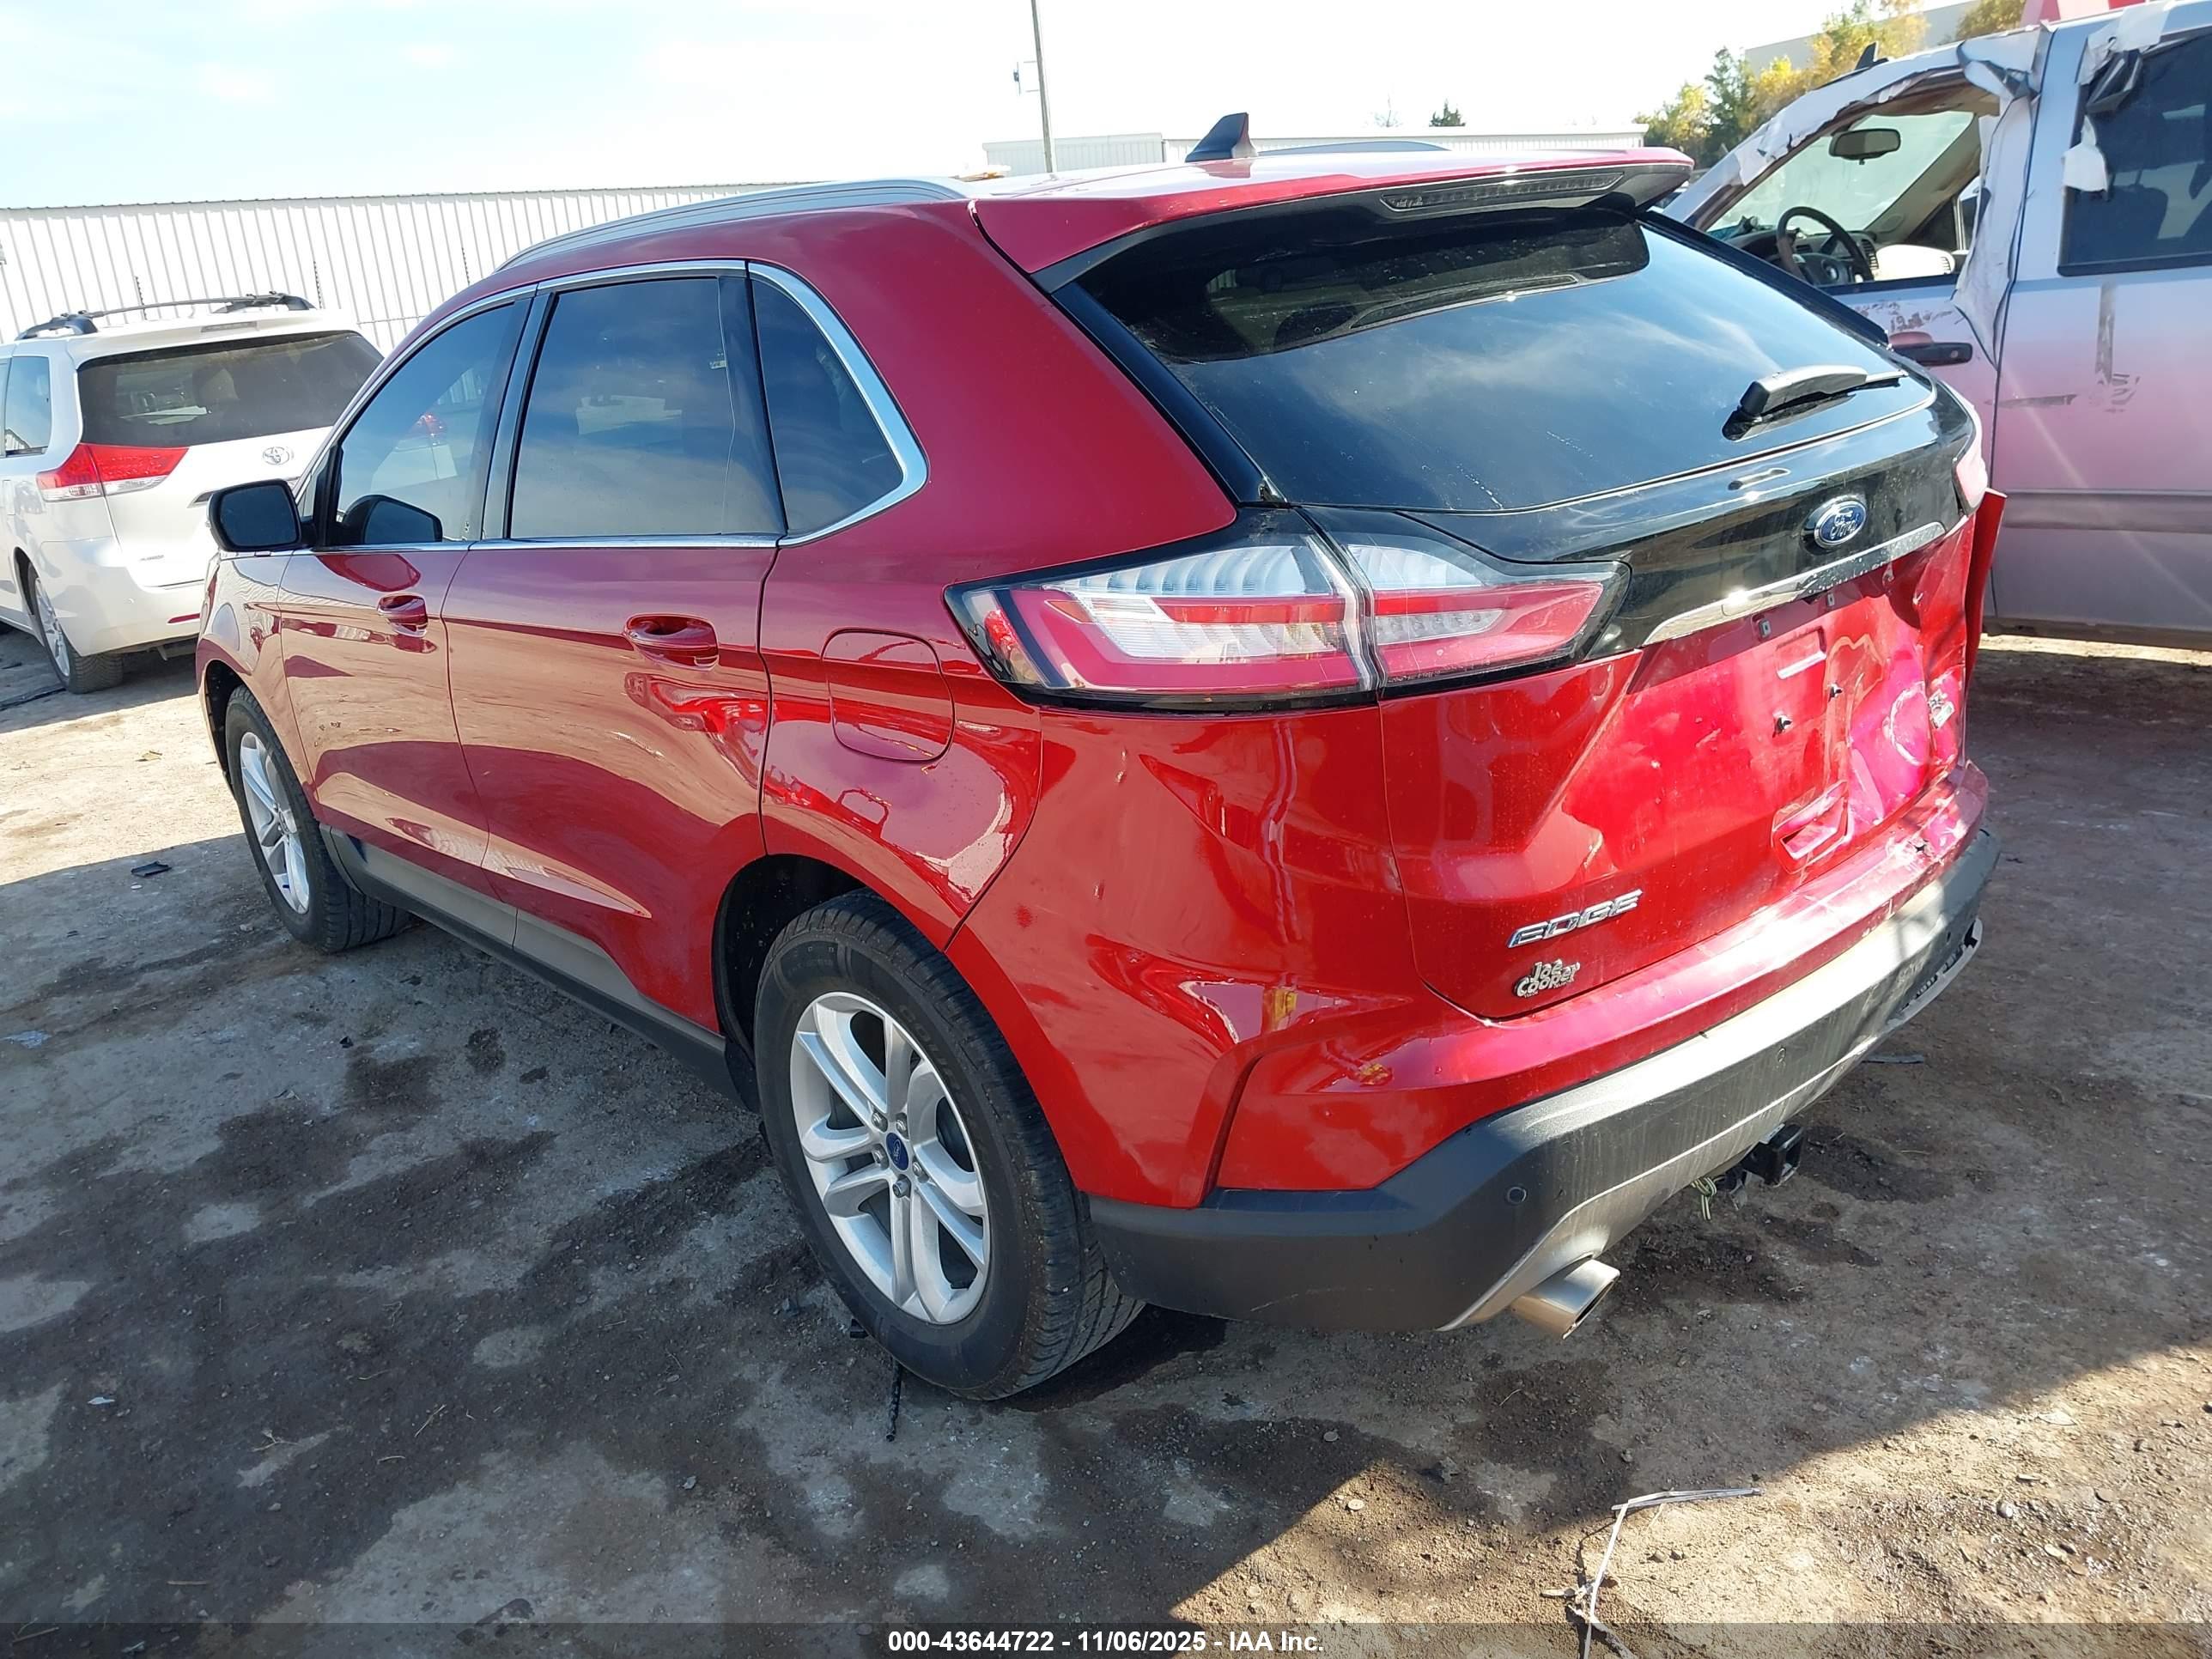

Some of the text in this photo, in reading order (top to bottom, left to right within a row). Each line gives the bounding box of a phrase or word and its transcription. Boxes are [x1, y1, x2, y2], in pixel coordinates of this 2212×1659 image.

[1507, 888, 1644, 949] EDGE
[1515, 962, 1580, 997] Cooper
[1530, 958, 1563, 981] Joe
